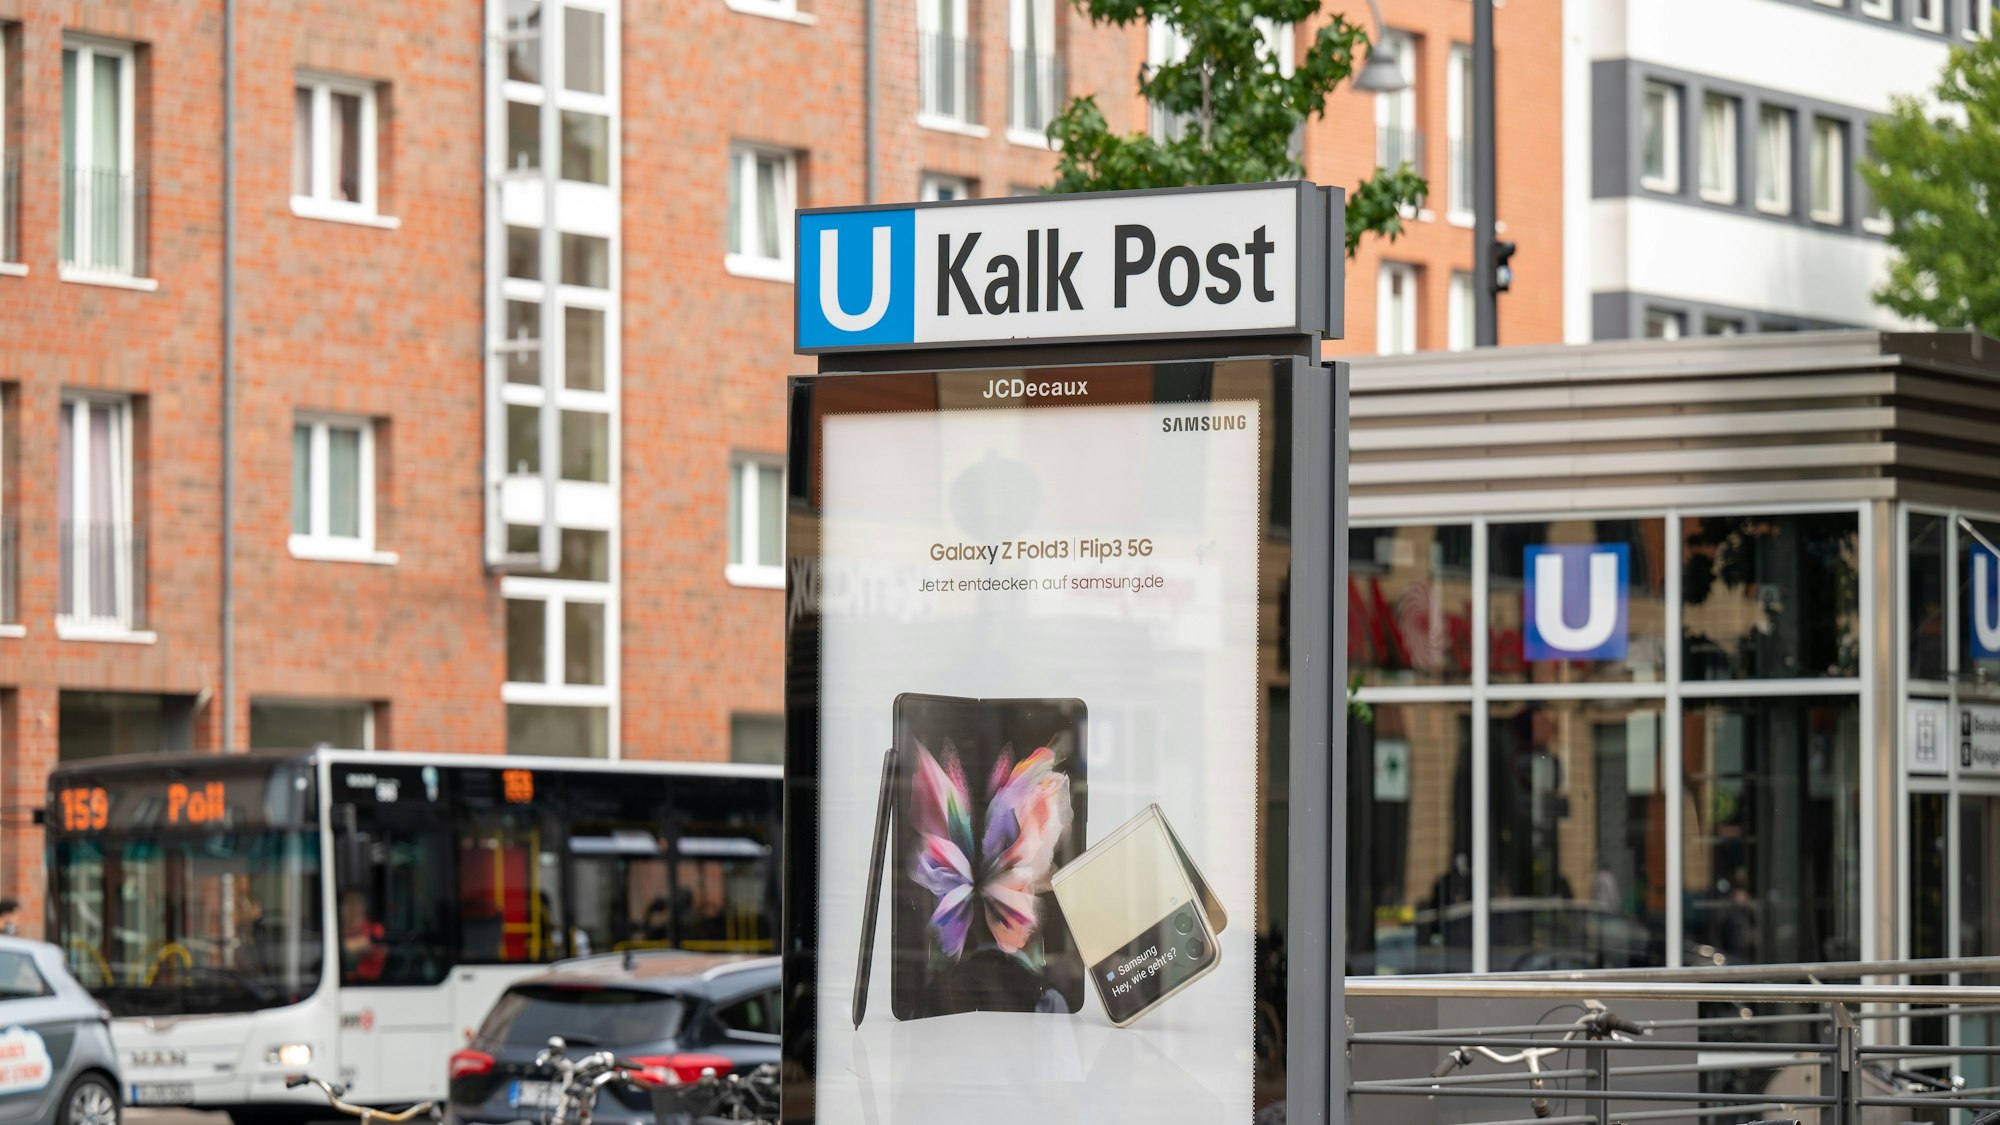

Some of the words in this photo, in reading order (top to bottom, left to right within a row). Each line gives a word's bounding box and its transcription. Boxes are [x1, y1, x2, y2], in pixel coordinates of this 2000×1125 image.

[820, 226, 891, 332] U
[937, 228, 1084, 316] Kalk
[1114, 224, 1275, 308] Post
[982, 378, 1089, 399] JCDecaux
[1162, 415, 1247, 433] SAMSUNG
[929, 543, 999, 565] Galaxy
[1001, 541, 1013, 560] Z
[1017, 540, 1069, 560] Fold3
[1079, 538, 1123, 564] Flip3
[1127, 538, 1153, 558] 5G
[918, 578, 956, 594] Jetzt
[958, 576, 1038, 592] entdecken
[1042, 574, 1069, 591] auf
[1071, 574, 1164, 593] samsung.de
[1535, 552, 1619, 652] U
[60, 787, 109, 832] 159
[168, 781, 226, 825] Poll
[1111, 980, 1133, 998] Hey,
[1131, 970, 1147, 985] wie
[1147, 946, 1177, 977] geht's?
[1118, 945, 1158, 976] Samsung
